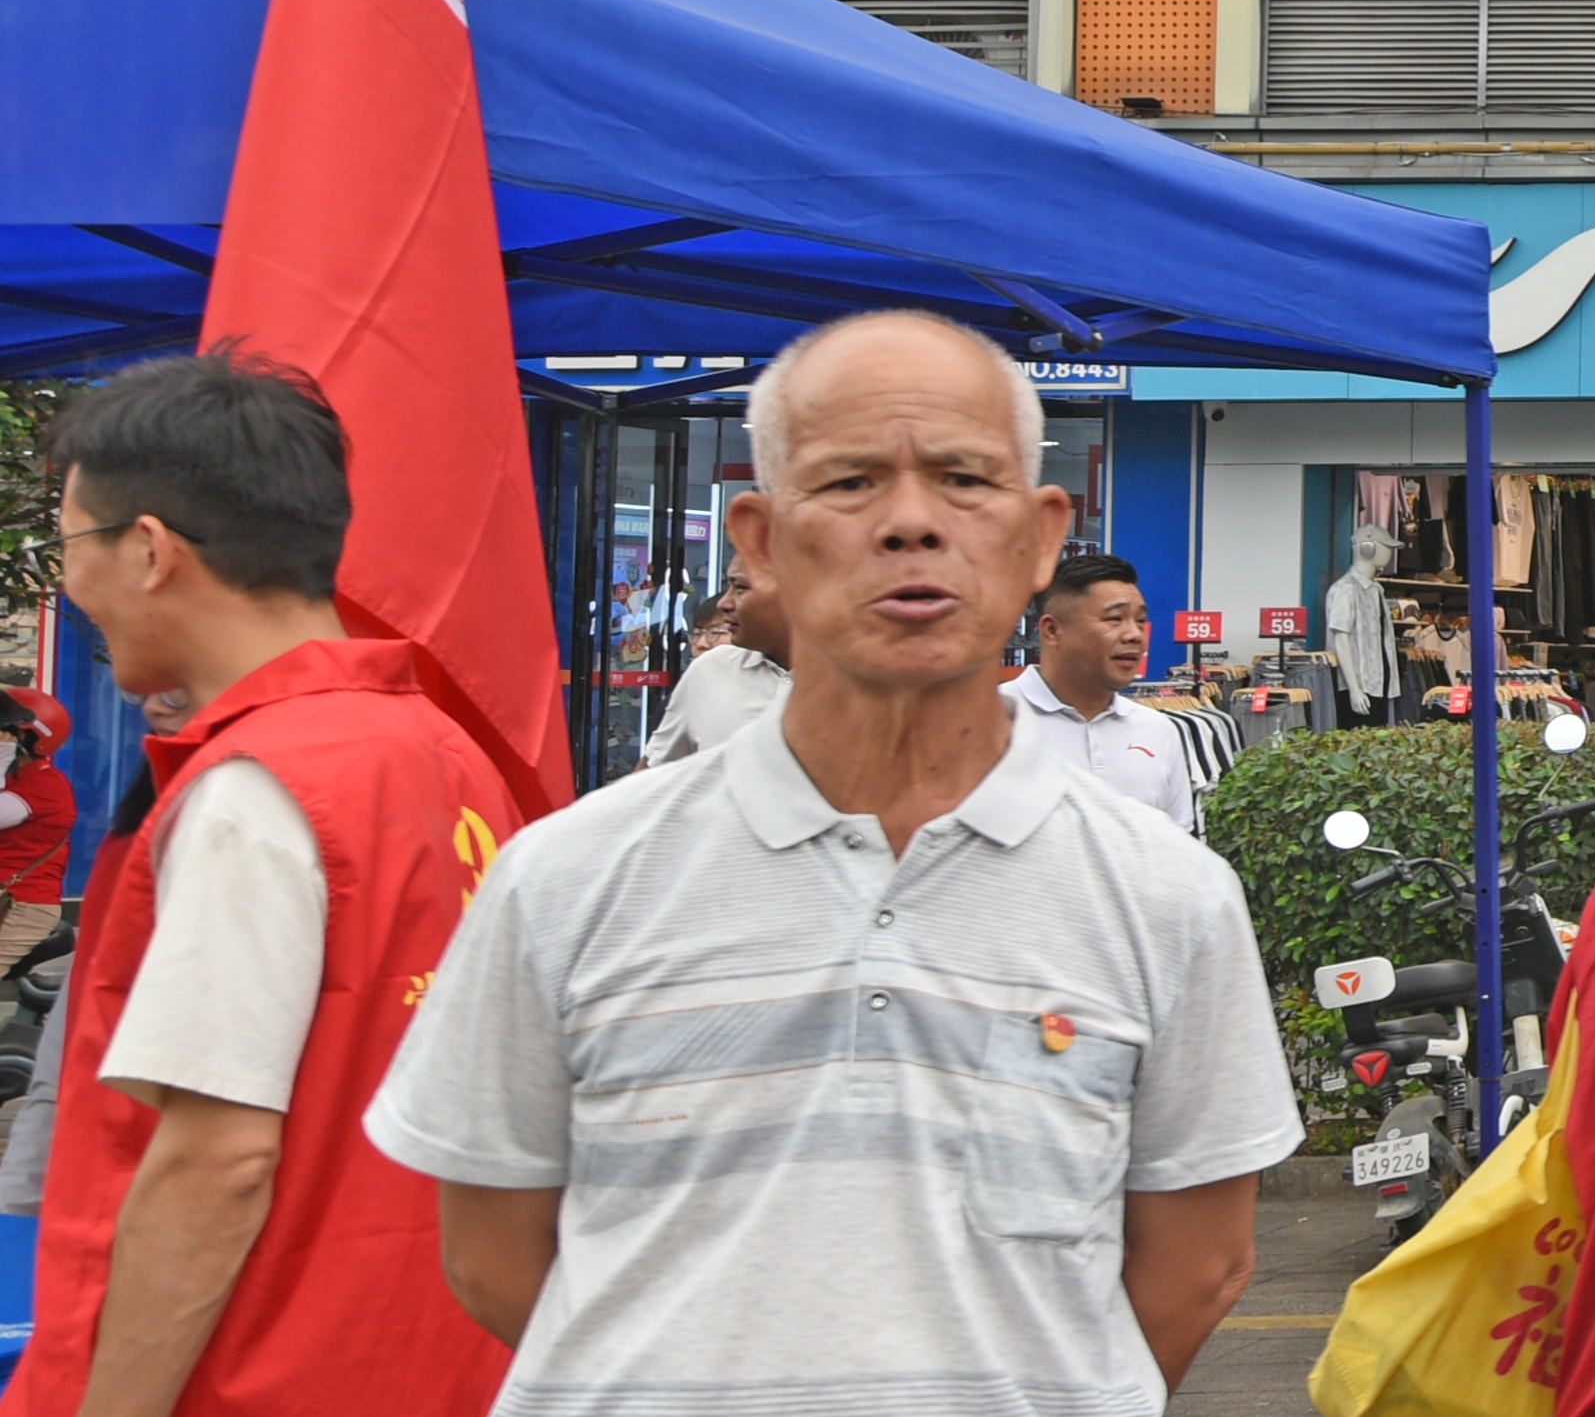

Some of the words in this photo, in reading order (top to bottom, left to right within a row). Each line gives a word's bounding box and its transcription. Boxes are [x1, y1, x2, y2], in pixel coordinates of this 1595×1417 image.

[1186, 622, 1211, 639] 59
[1270, 618, 1295, 635] 59
[1358, 1150, 1425, 1181] 349226
